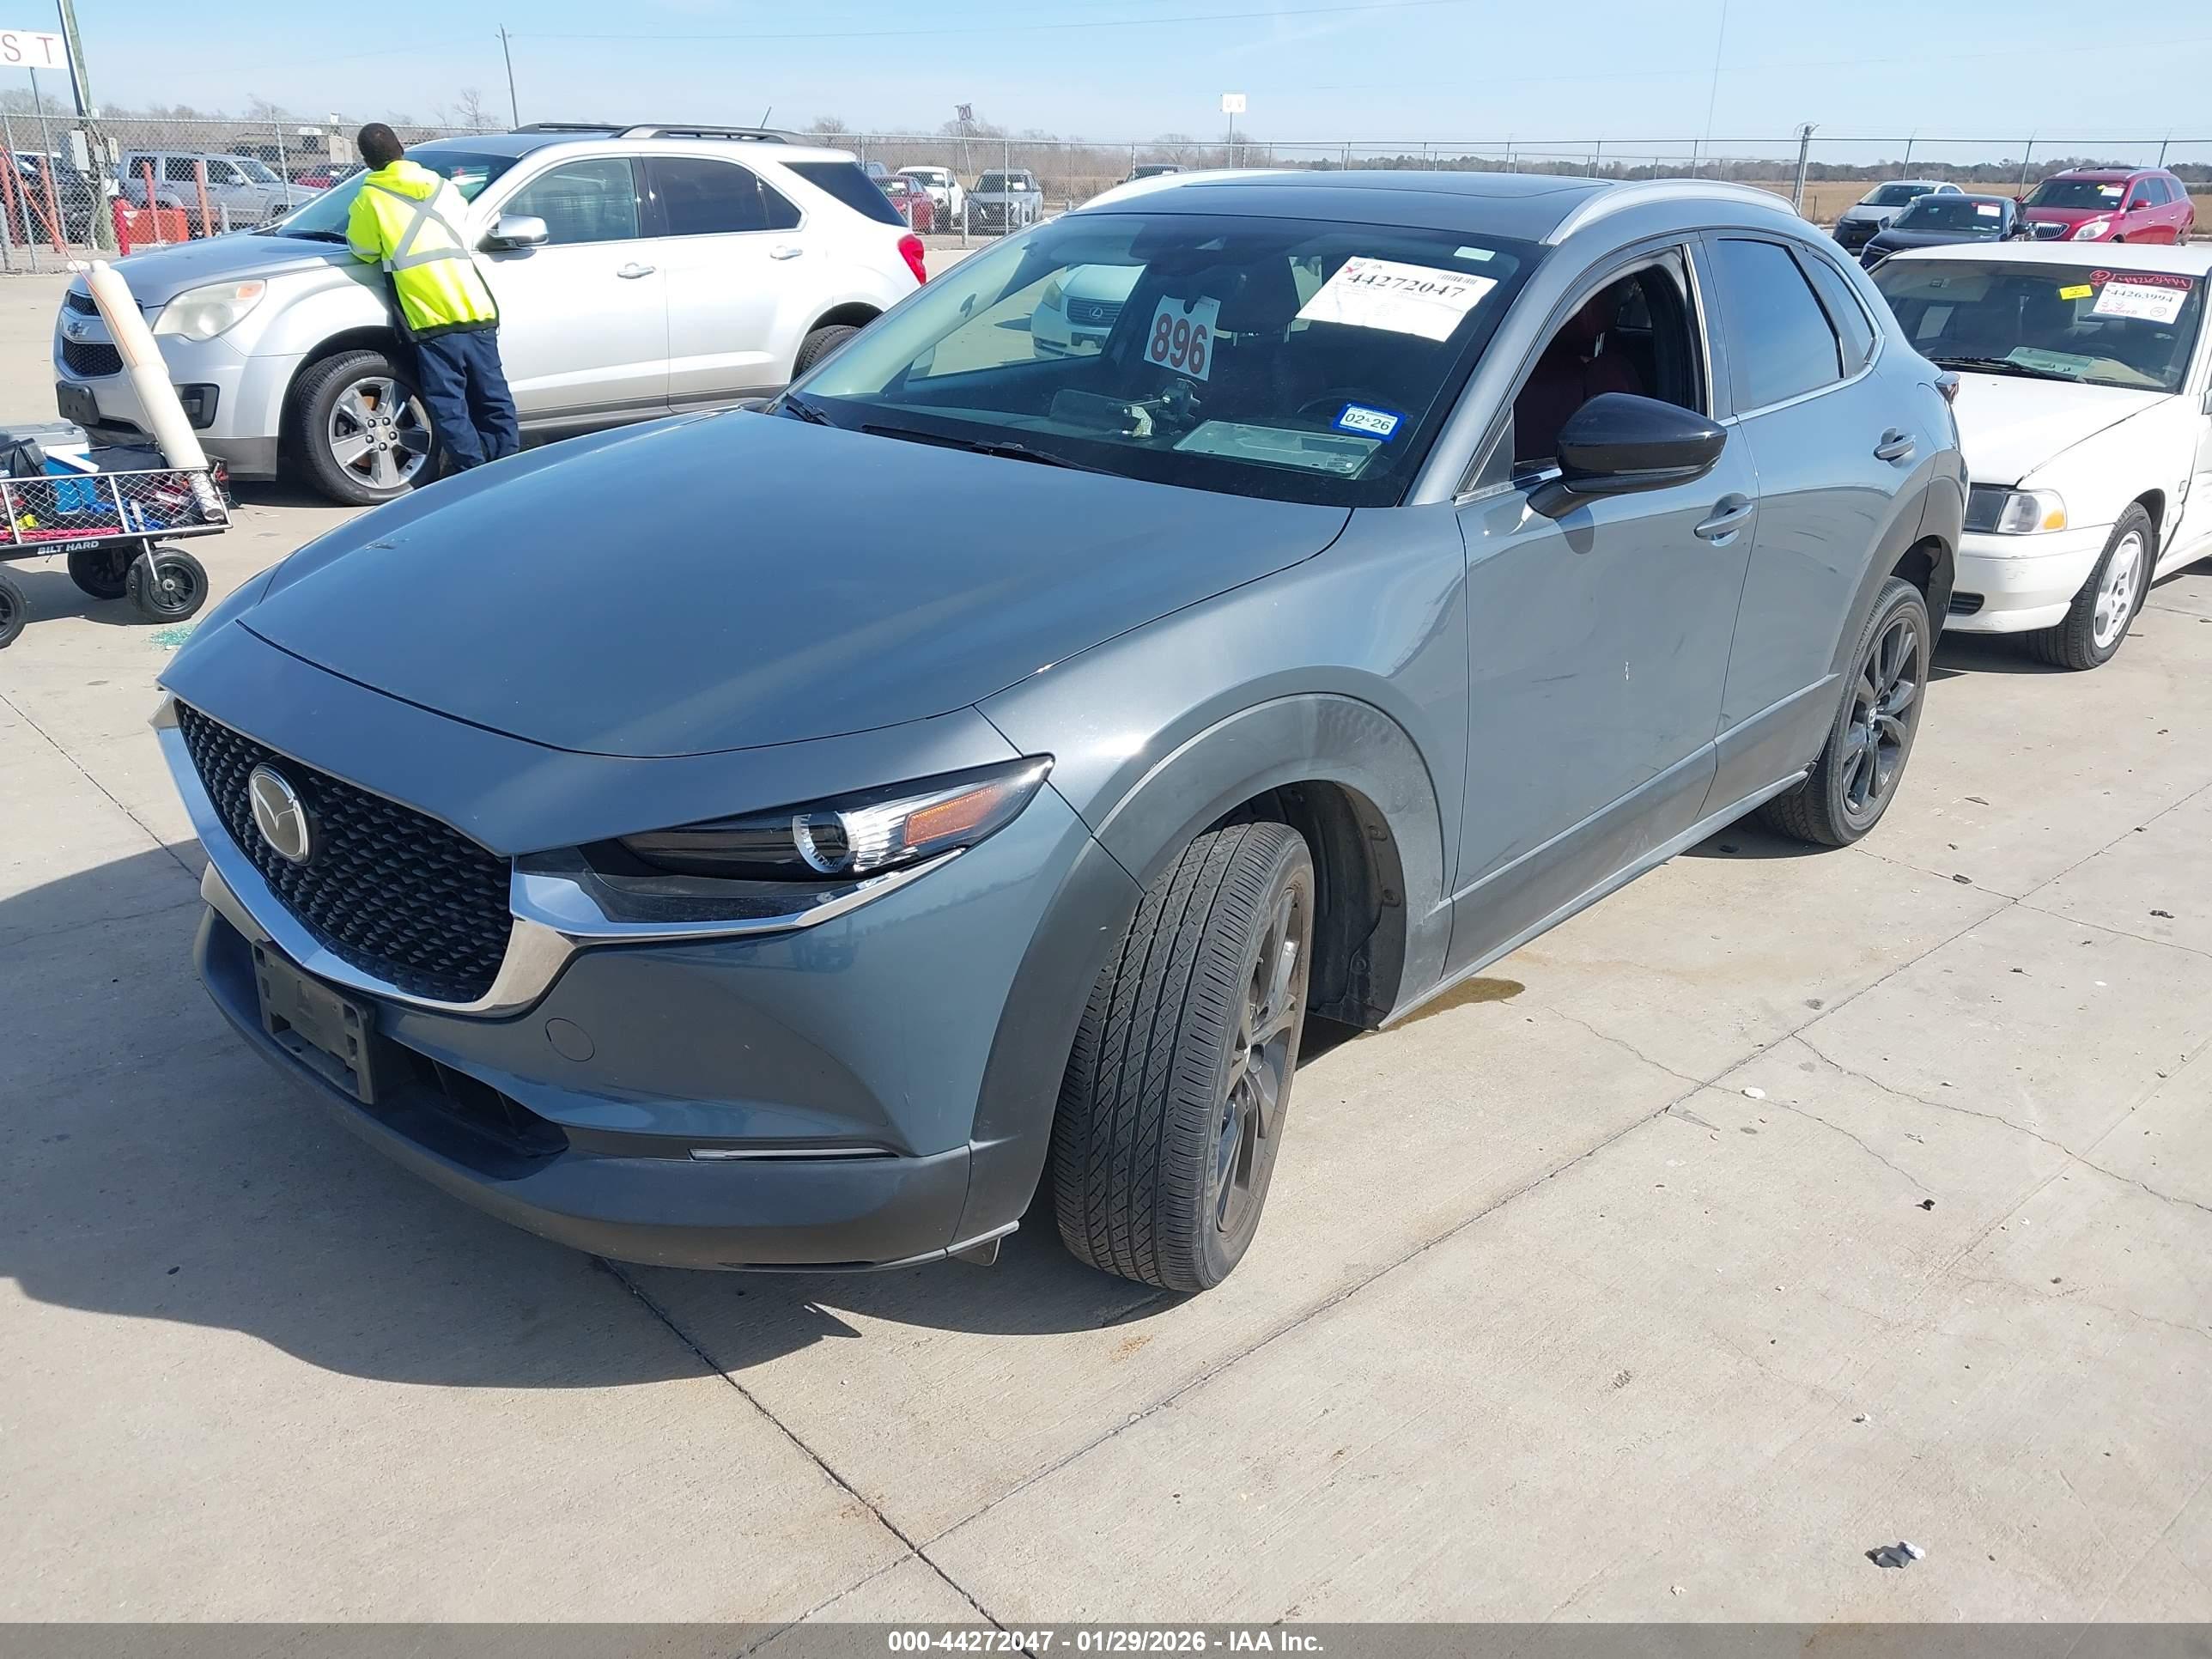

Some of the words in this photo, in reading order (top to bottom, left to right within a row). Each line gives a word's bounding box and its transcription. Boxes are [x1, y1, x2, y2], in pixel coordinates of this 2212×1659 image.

[959, 106, 971, 120] 20
[1347, 272, 1467, 298] 44272047
[2111, 289, 2173, 302] 44263994
[1151, 313, 1207, 374] 896
[37, 544, 64, 555] BILT
[65, 540, 100, 552] HARD
